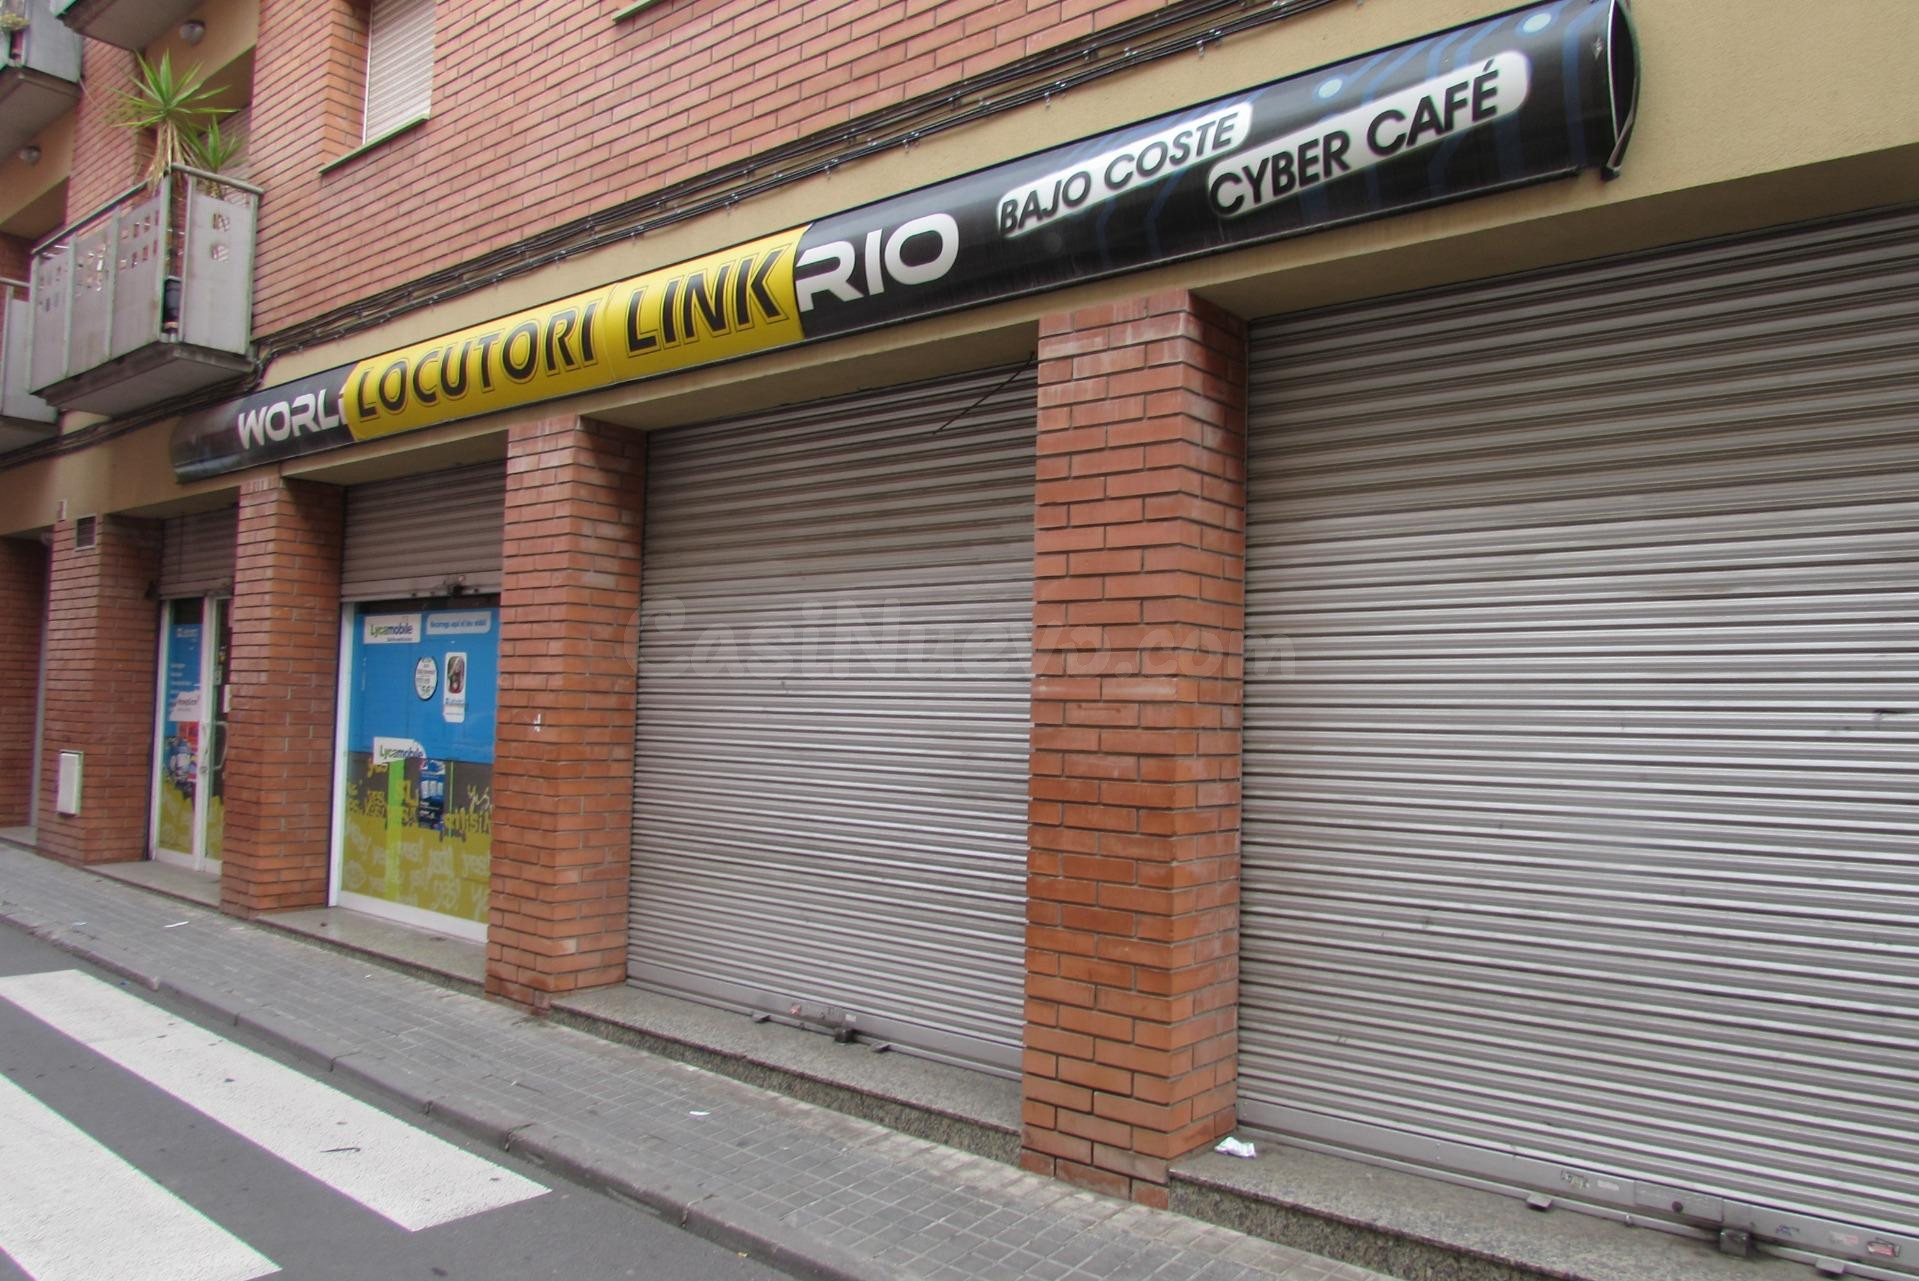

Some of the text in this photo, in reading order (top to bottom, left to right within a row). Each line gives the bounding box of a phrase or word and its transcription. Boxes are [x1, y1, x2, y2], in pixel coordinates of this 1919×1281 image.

[1001, 113, 1236, 234] BAJO COSTE
[1208, 60, 1500, 216] CYBER CAFÉ
[355, 247, 796, 420] LOCUTORI LINK
[235, 388, 345, 450] WORL
